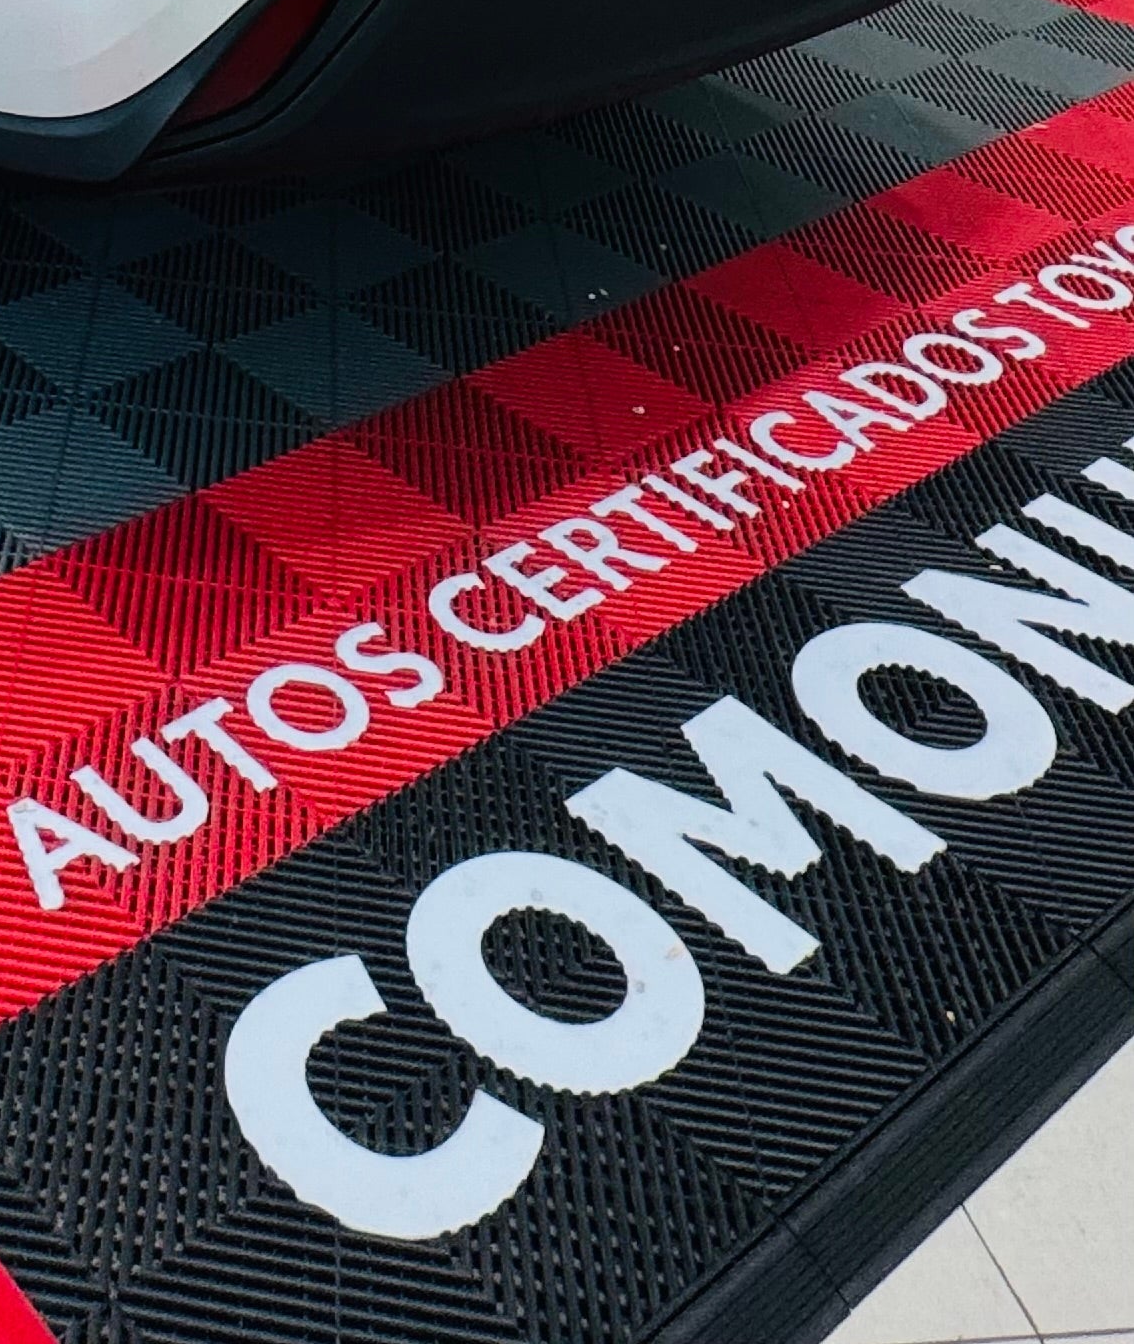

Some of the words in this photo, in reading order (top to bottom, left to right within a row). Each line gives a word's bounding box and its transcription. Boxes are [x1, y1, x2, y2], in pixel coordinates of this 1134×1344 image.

[7, 621, 444, 910] AUTOS
[428, 307, 1047, 653] CERTIFICADOS
[994, 224, 1134, 329] TOY
